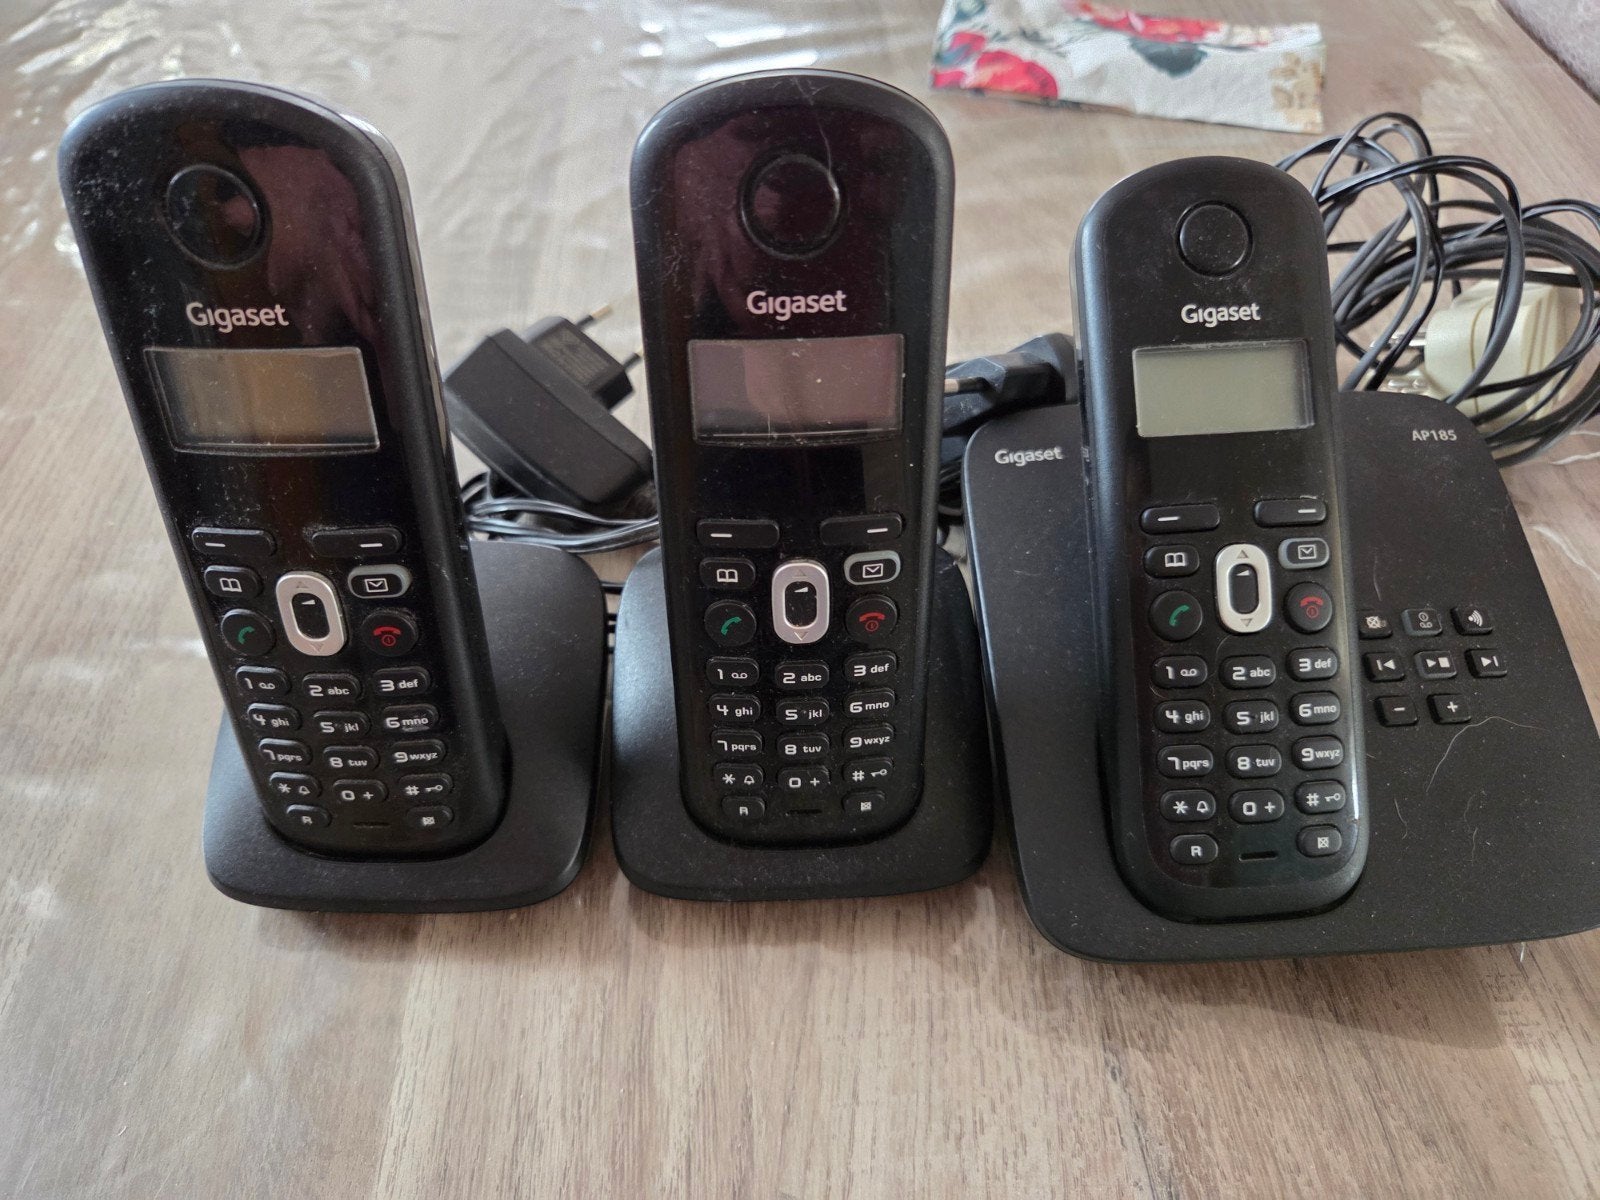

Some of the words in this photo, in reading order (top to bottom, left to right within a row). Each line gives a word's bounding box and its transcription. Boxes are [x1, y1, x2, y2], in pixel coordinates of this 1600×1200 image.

[746, 290, 847, 321] Gigaset
[186, 301, 289, 333] Gigaset
[1181, 302, 1261, 328] Gigaset
[1412, 429, 1458, 443] AP185
[994, 446, 1063, 467] Gigaset
[853, 665, 867, 676] 3
[870, 662, 889, 674] def
[1299, 659, 1310, 671] 3
[1314, 657, 1331, 669] def
[717, 669, 724, 679] 1
[782, 672, 796, 683] 2
[800, 673, 822, 682] abc
[1166, 665, 1174, 679] 1
[1232, 667, 1246, 681] 2
[1249, 667, 1270, 678] abc
[245, 678, 253, 689] 1
[380, 680, 395, 691] 3
[398, 679, 419, 689] def
[309, 685, 324, 696] 2
[327, 686, 350, 695] abc
[717, 705, 728, 715] 4
[735, 706, 753, 717] ghi
[850, 702, 863, 713] 6
[865, 701, 889, 711] mno
[1299, 704, 1311, 716] 6
[1313, 704, 1336, 714] mno
[785, 709, 798, 720] 5
[808, 708, 823, 720] jkl
[1165, 710, 1179, 724] 4
[1184, 710, 1204, 724] ghi
[1236, 711, 1250, 725] 5
[1259, 710, 1275, 723] jkl
[253, 714, 267, 725] 4
[270, 717, 289, 727] ghi
[385, 717, 400, 728] 6
[320, 721, 335, 733] 5
[344, 722, 359, 733] jkl
[731, 741, 756, 752] pqrs
[850, 737, 862, 748] 9
[863, 735, 890, 745] wxyz
[784, 744, 797, 755] 8
[802, 744, 822, 754] tuv
[1302, 748, 1314, 761] 9
[1315, 748, 1340, 760] wxyz
[329, 757, 344, 768] 8
[348, 759, 368, 767] tuv
[394, 751, 408, 763] 9
[409, 752, 438, 761] wxyz
[1237, 756, 1250, 770] 8
[1255, 756, 1275, 767] tuv
[1182, 757, 1210, 770] pqrs
[1190, 845, 1201, 856] R
